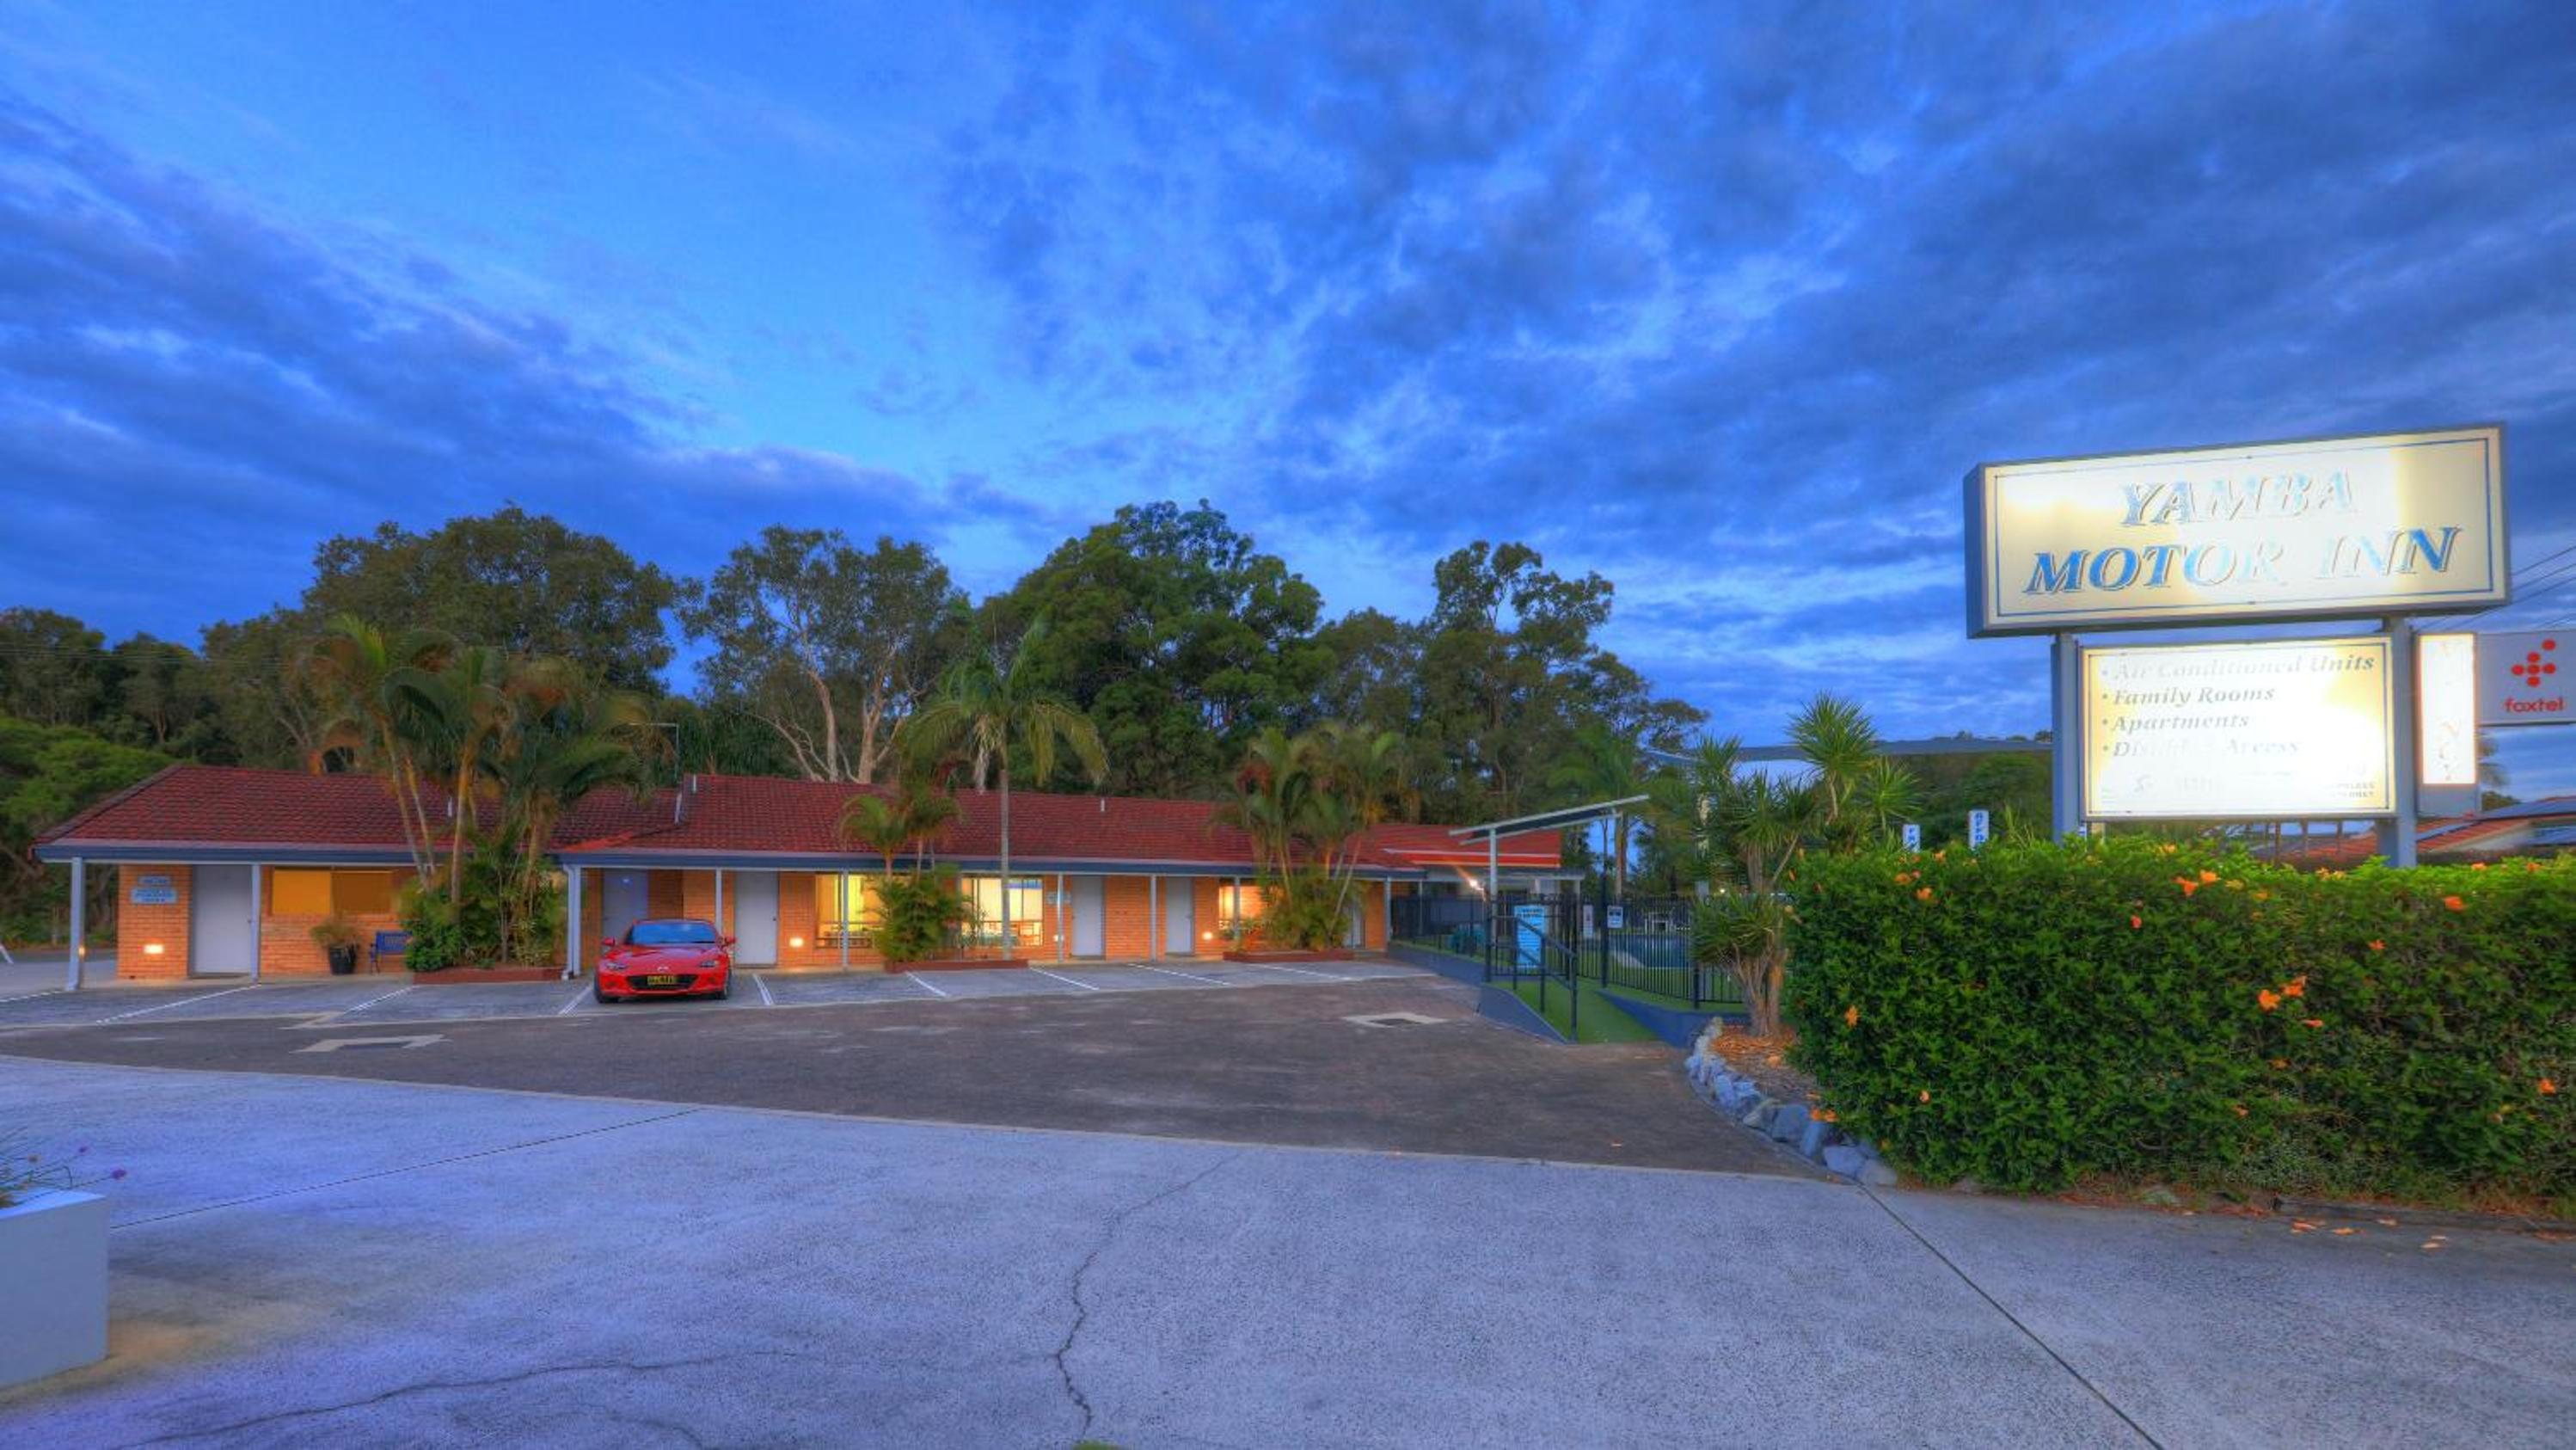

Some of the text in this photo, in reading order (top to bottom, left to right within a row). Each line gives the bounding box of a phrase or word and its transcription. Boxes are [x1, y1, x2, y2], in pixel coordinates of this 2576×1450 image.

[2120, 469, 2354, 526] YAMBA
[2023, 525, 2462, 594] MOTOR INN
[2309, 653, 2376, 673] Units
[2113, 686, 2276, 708] Family Rooms
[2504, 695, 2565, 713] foxtel
[2110, 715, 2249, 734] Apartments
